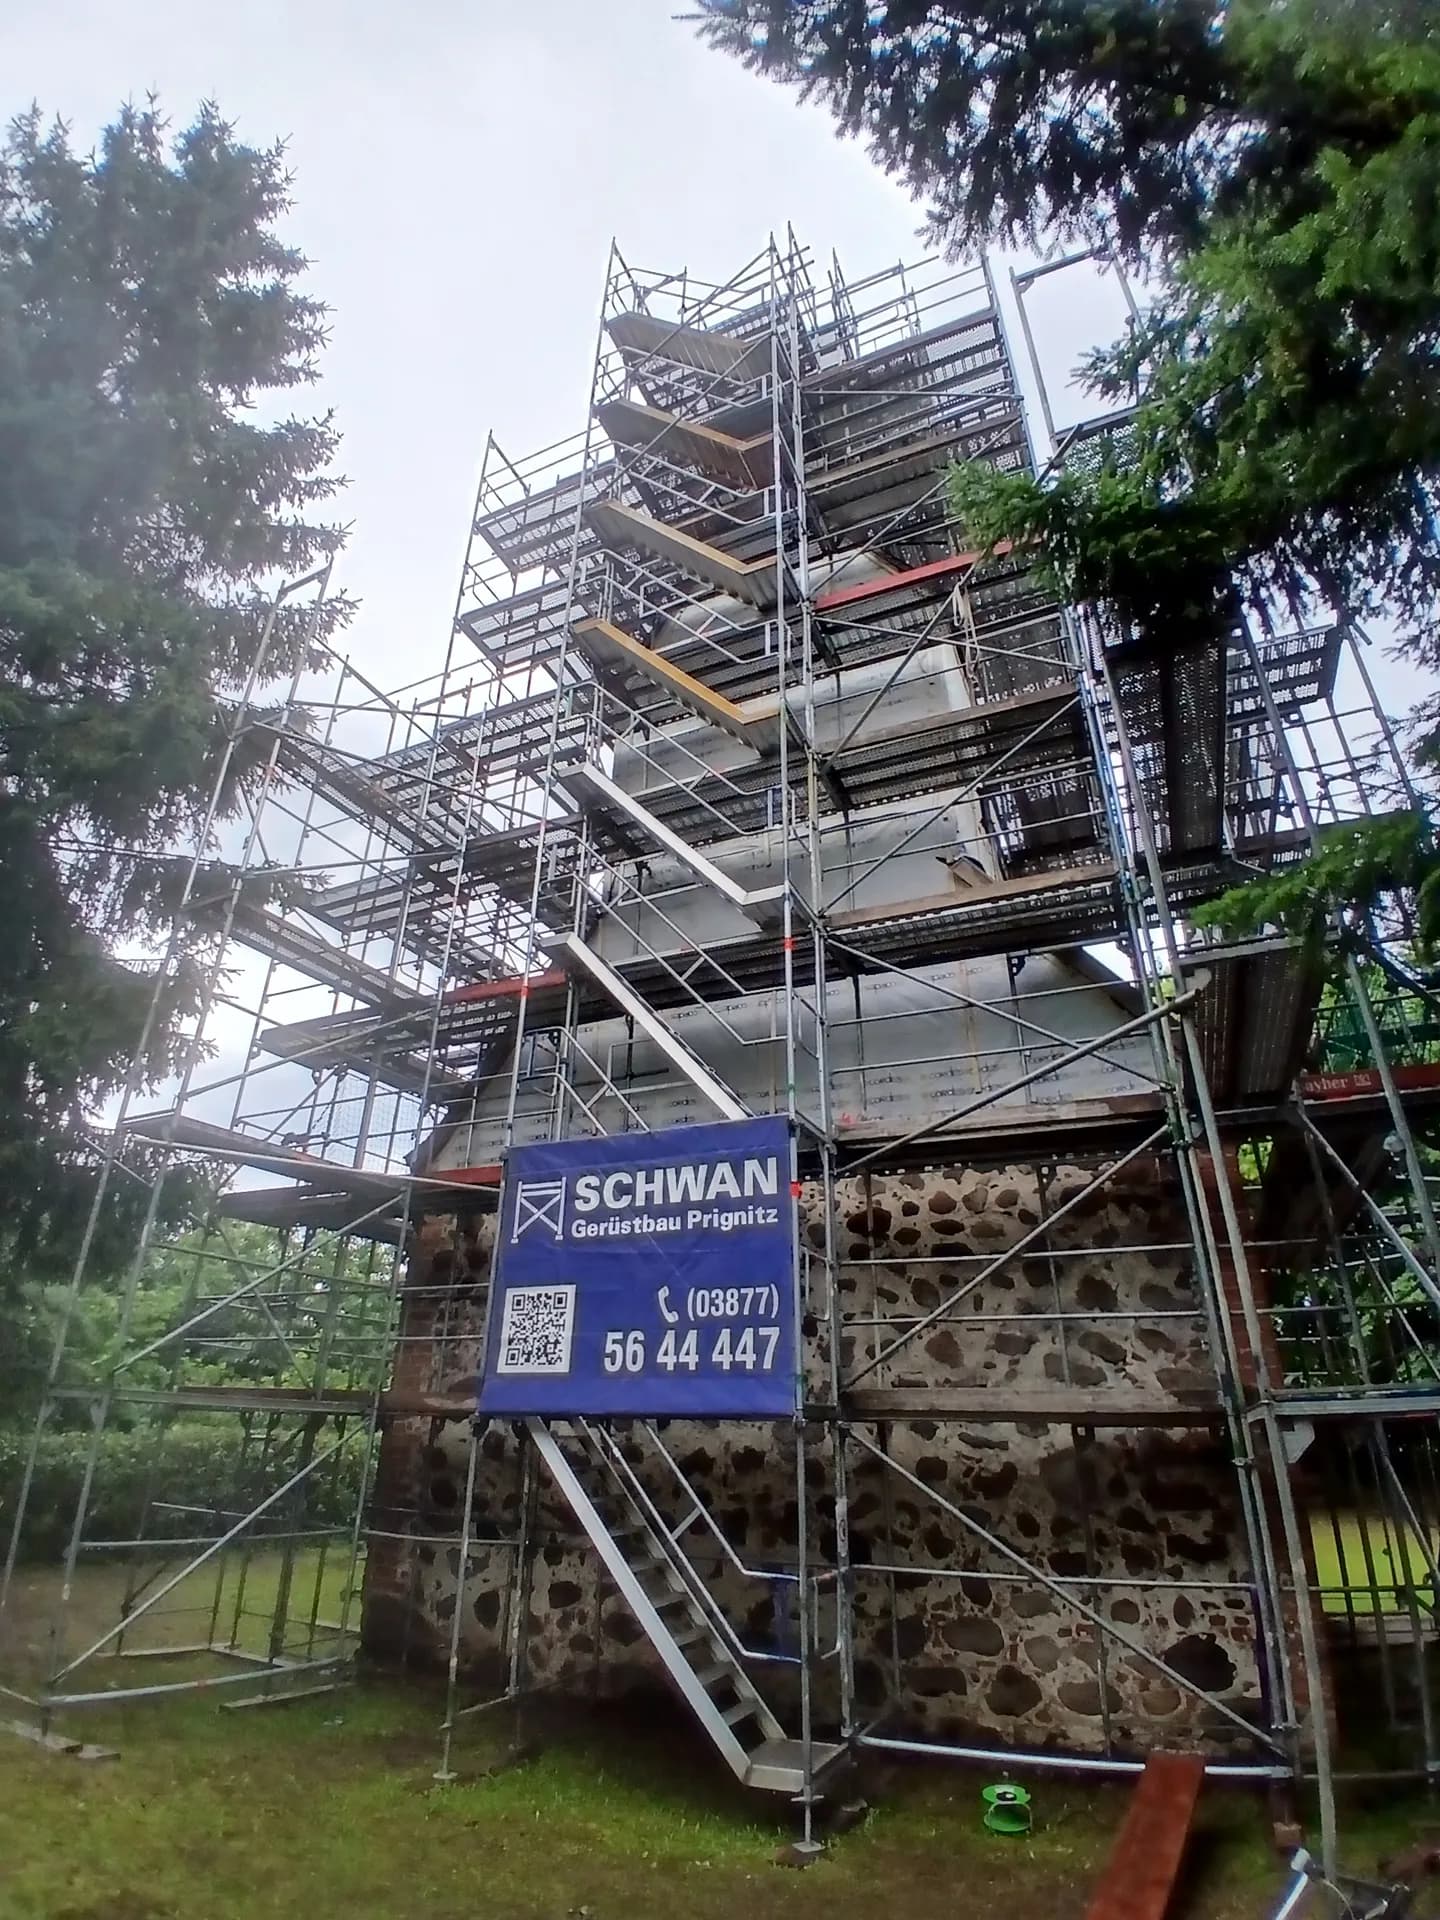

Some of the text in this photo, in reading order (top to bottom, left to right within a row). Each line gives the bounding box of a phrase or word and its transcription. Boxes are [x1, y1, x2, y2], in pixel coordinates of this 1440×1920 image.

[1304, 1077, 1349, 1094] ayher
[574, 1156, 778, 1212] SCHWAN
[571, 1206, 779, 1239] Gerüstbau Prignitz
[687, 1283, 780, 1322] (03877)
[603, 1326, 780, 1373] 56 44 447
